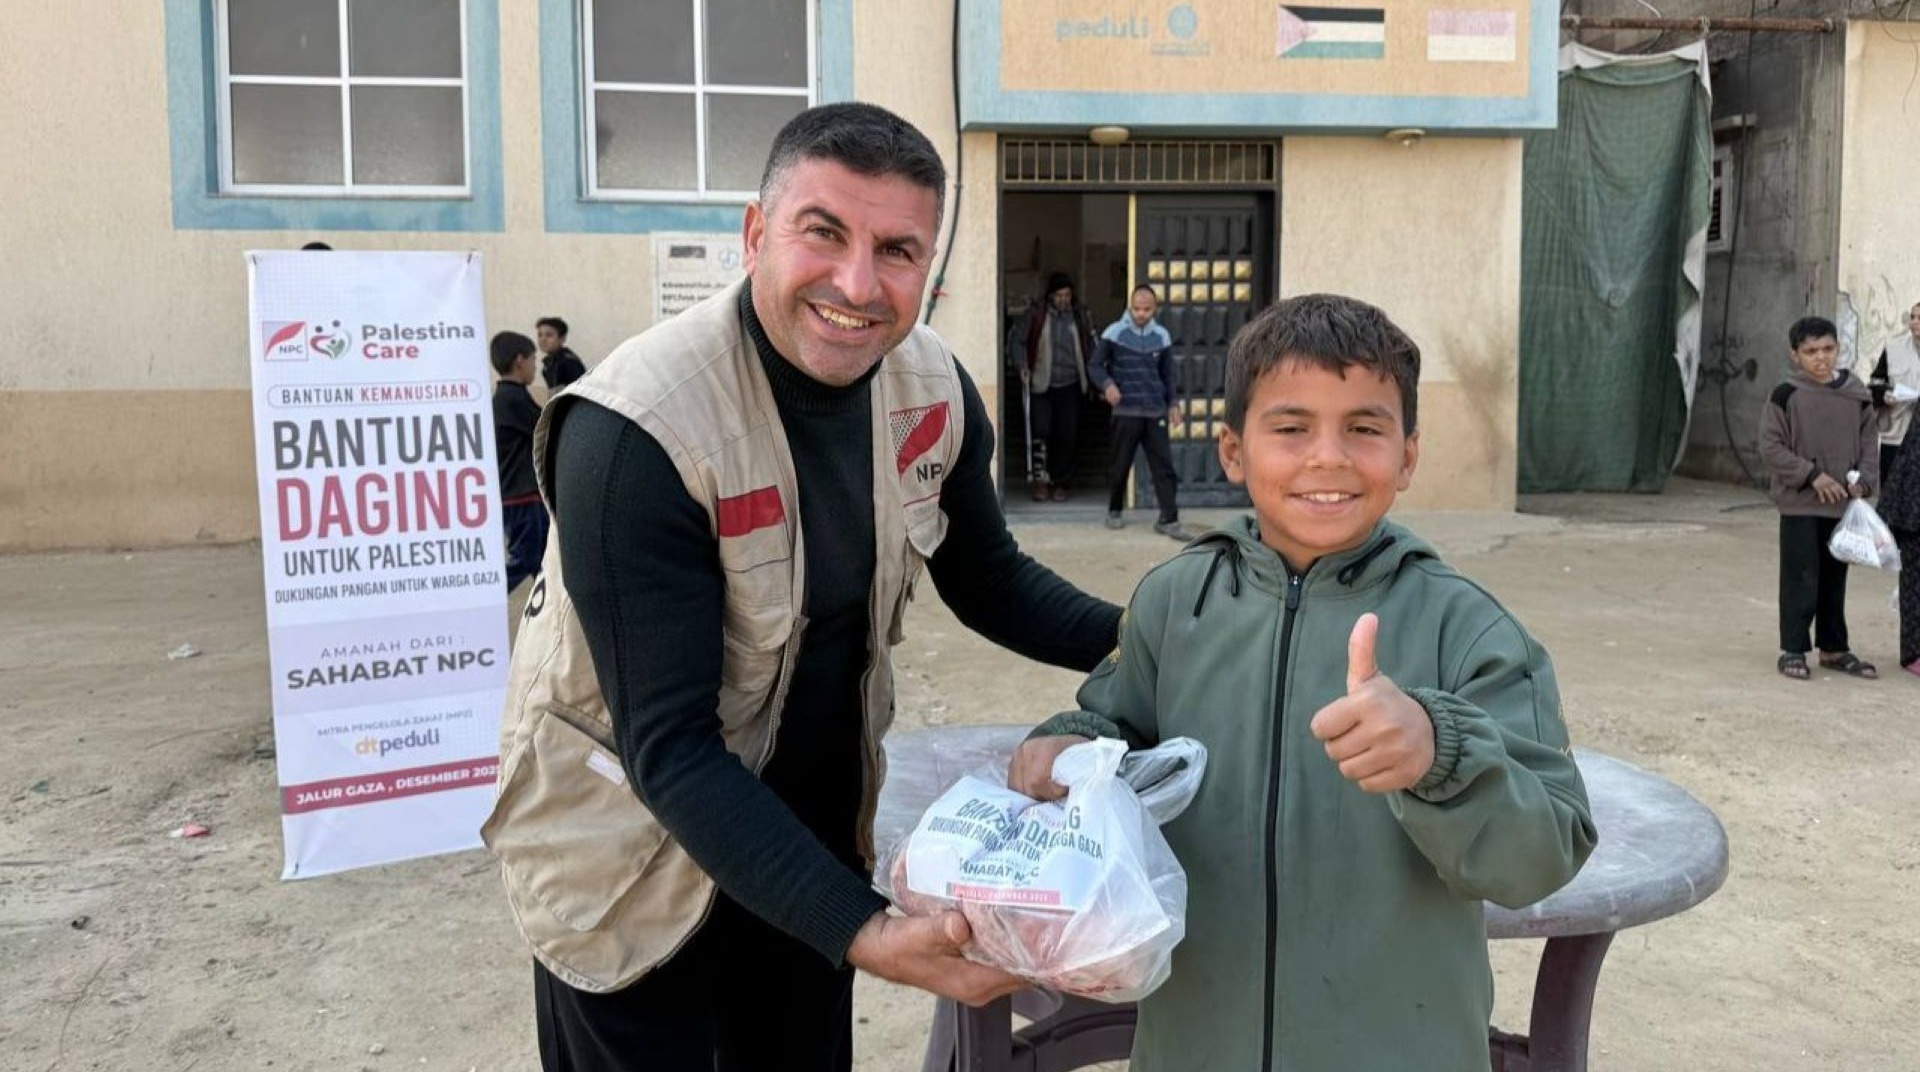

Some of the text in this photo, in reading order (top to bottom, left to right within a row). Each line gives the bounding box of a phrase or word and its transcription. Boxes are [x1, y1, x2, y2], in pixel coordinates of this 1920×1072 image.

[361, 322, 475, 341] Palestina
[279, 345, 303, 354] NPC
[362, 343, 419, 359] Care
[282, 384, 469, 404] BANTUAN KEMANUSIAAN
[273, 413, 484, 471] BANTUAN
[276, 467, 488, 541] DAGING
[284, 537, 486, 577] UNTUK PALESTINA
[275, 571, 500, 603] DUKUNGAN PANGAN UNTUK WARGA GAZA
[320, 640, 400, 659] AMANAH
[410, 635, 452, 649] DARI
[288, 648, 495, 690] SAHABAT NPC
[318, 726, 349, 737] MITRA
[352, 719, 410, 732] PENGELOLA
[413, 715, 443, 725] ZAKAT
[355, 728, 440, 757] dtpeduli
[297, 788, 342, 805] JALUR
[345, 782, 385, 796] GAZA
[396, 769, 470, 790] DESEMBER
[1078, 834, 1102, 860] GAZA
